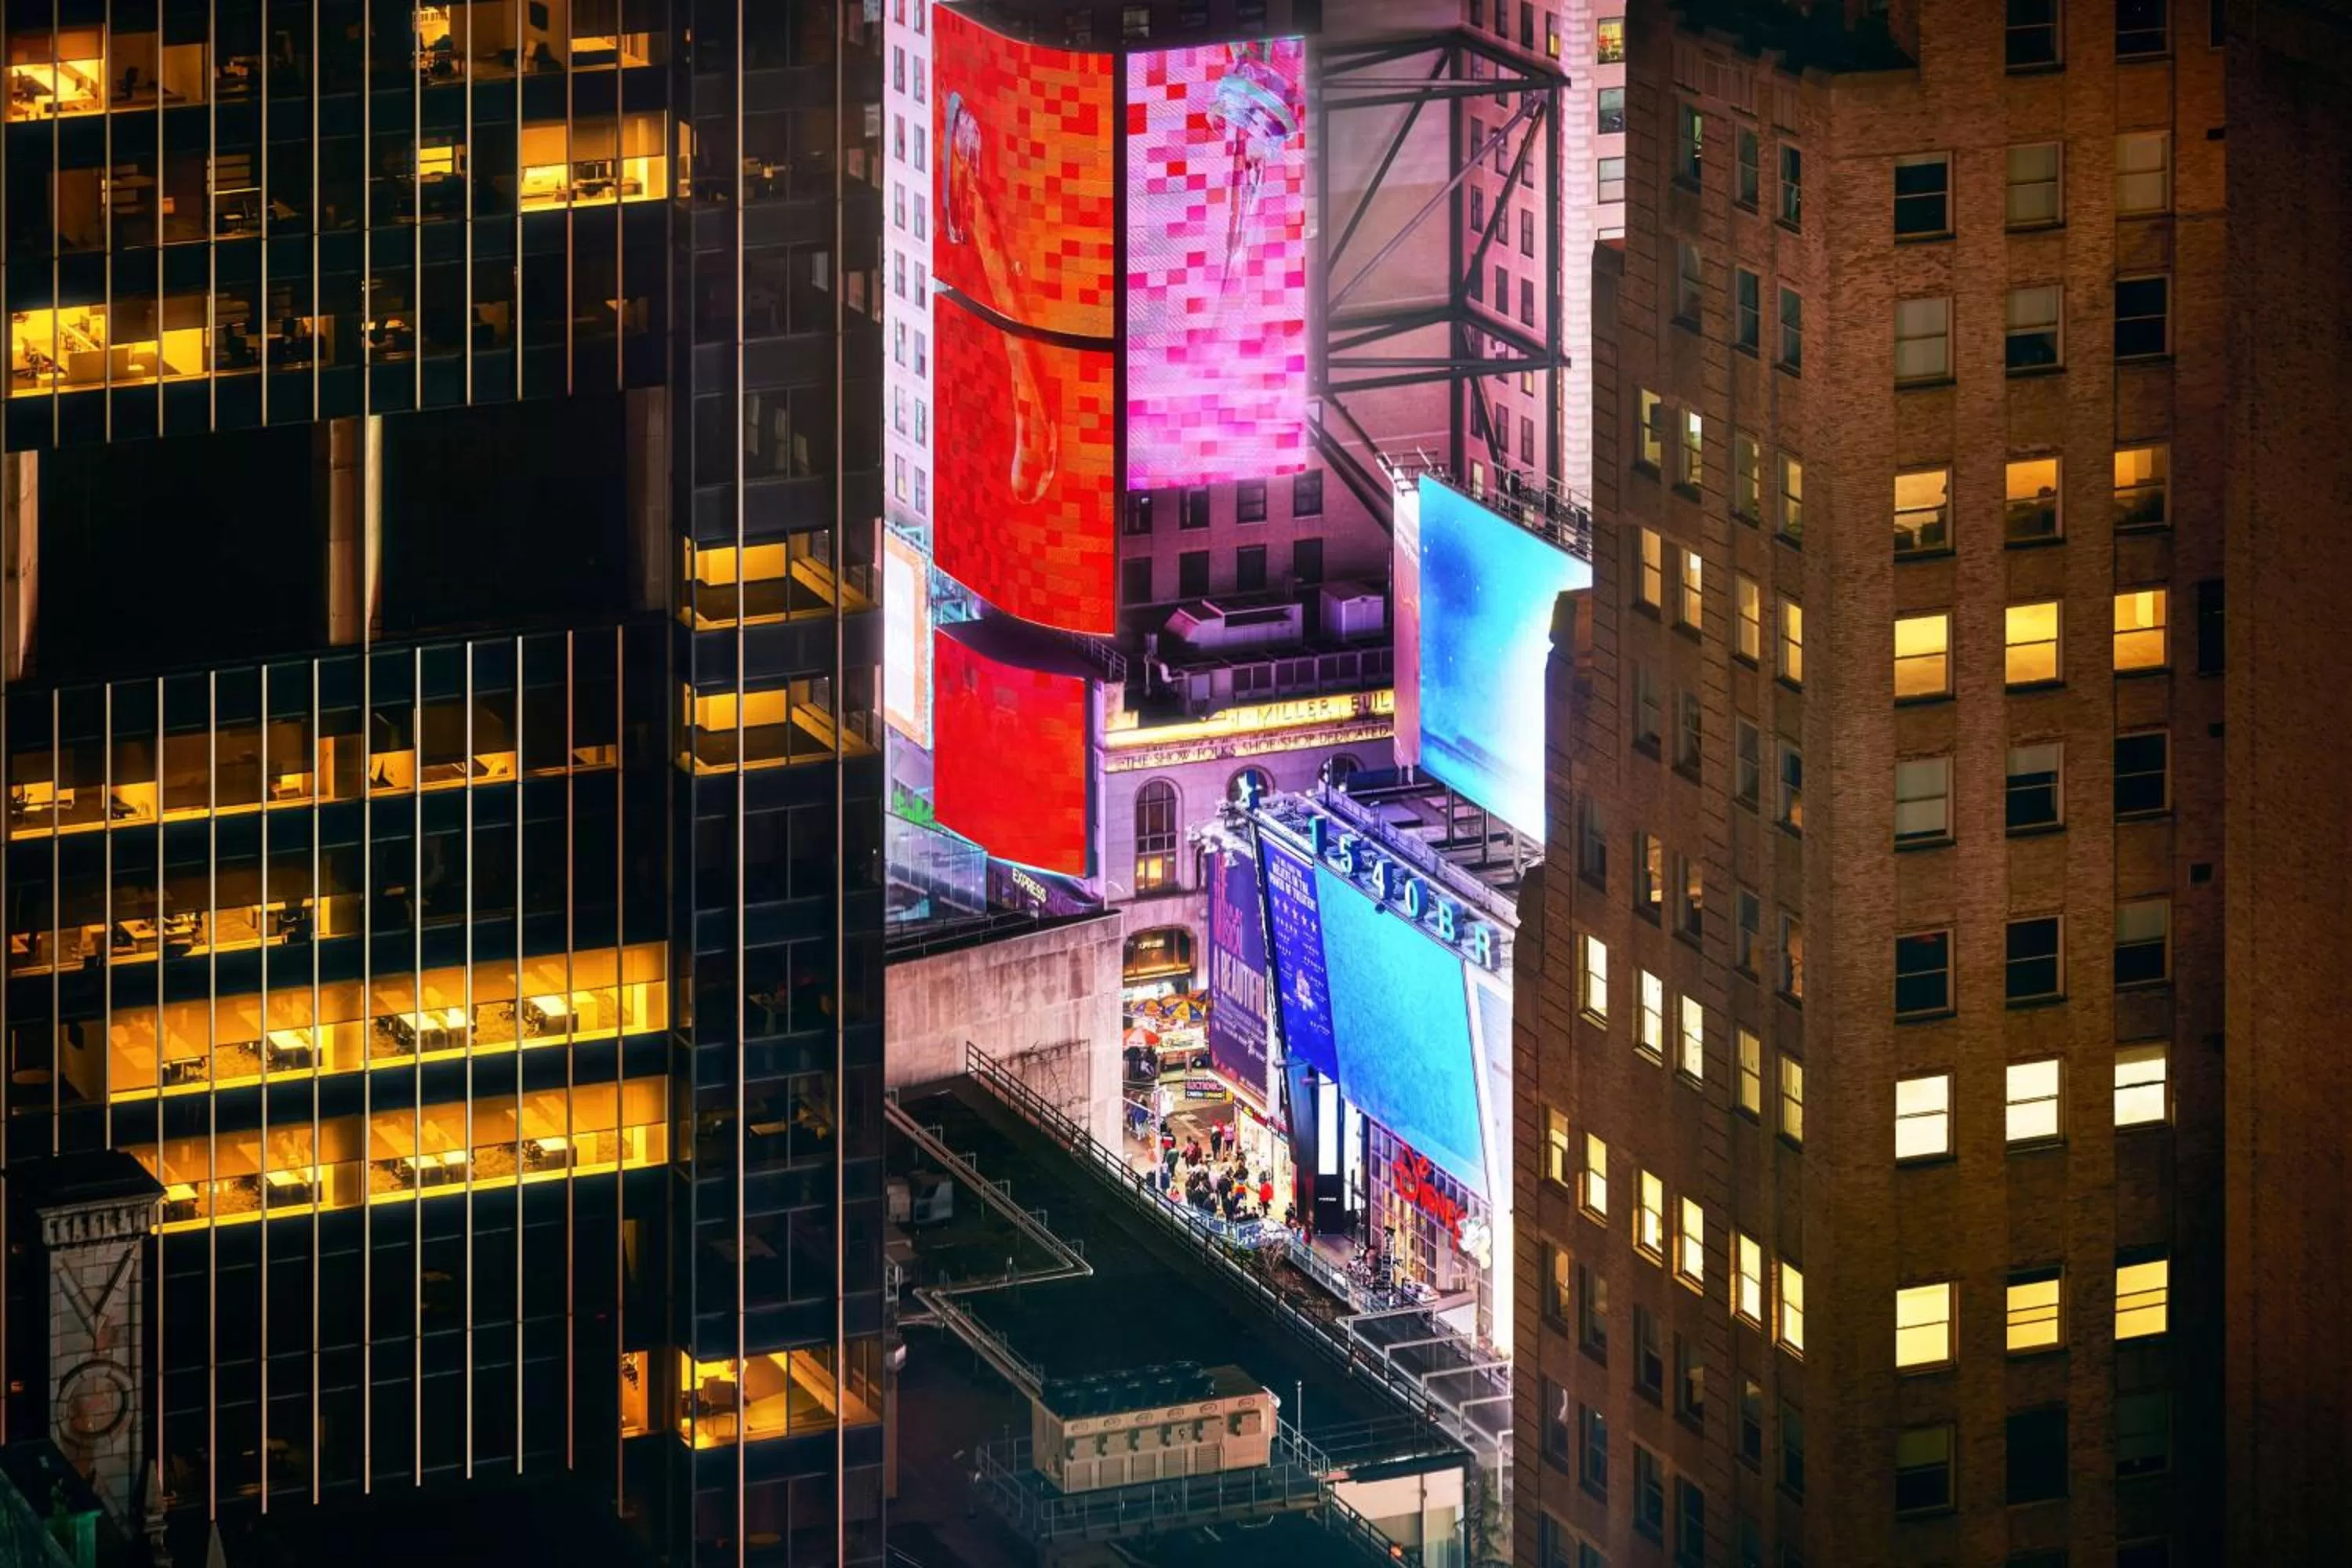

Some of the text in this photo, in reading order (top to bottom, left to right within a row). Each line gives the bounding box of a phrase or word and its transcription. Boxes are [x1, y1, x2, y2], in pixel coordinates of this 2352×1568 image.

[1258, 699, 1333, 724] MILLER
[1352, 691, 1391, 712] BUIL
[1125, 724, 1388, 768] THE SHOW FOLKS SHOE SHOP DEDICATED
[1011, 867, 1047, 902] EXPRESS
[1311, 815, 1425, 920] 1540
